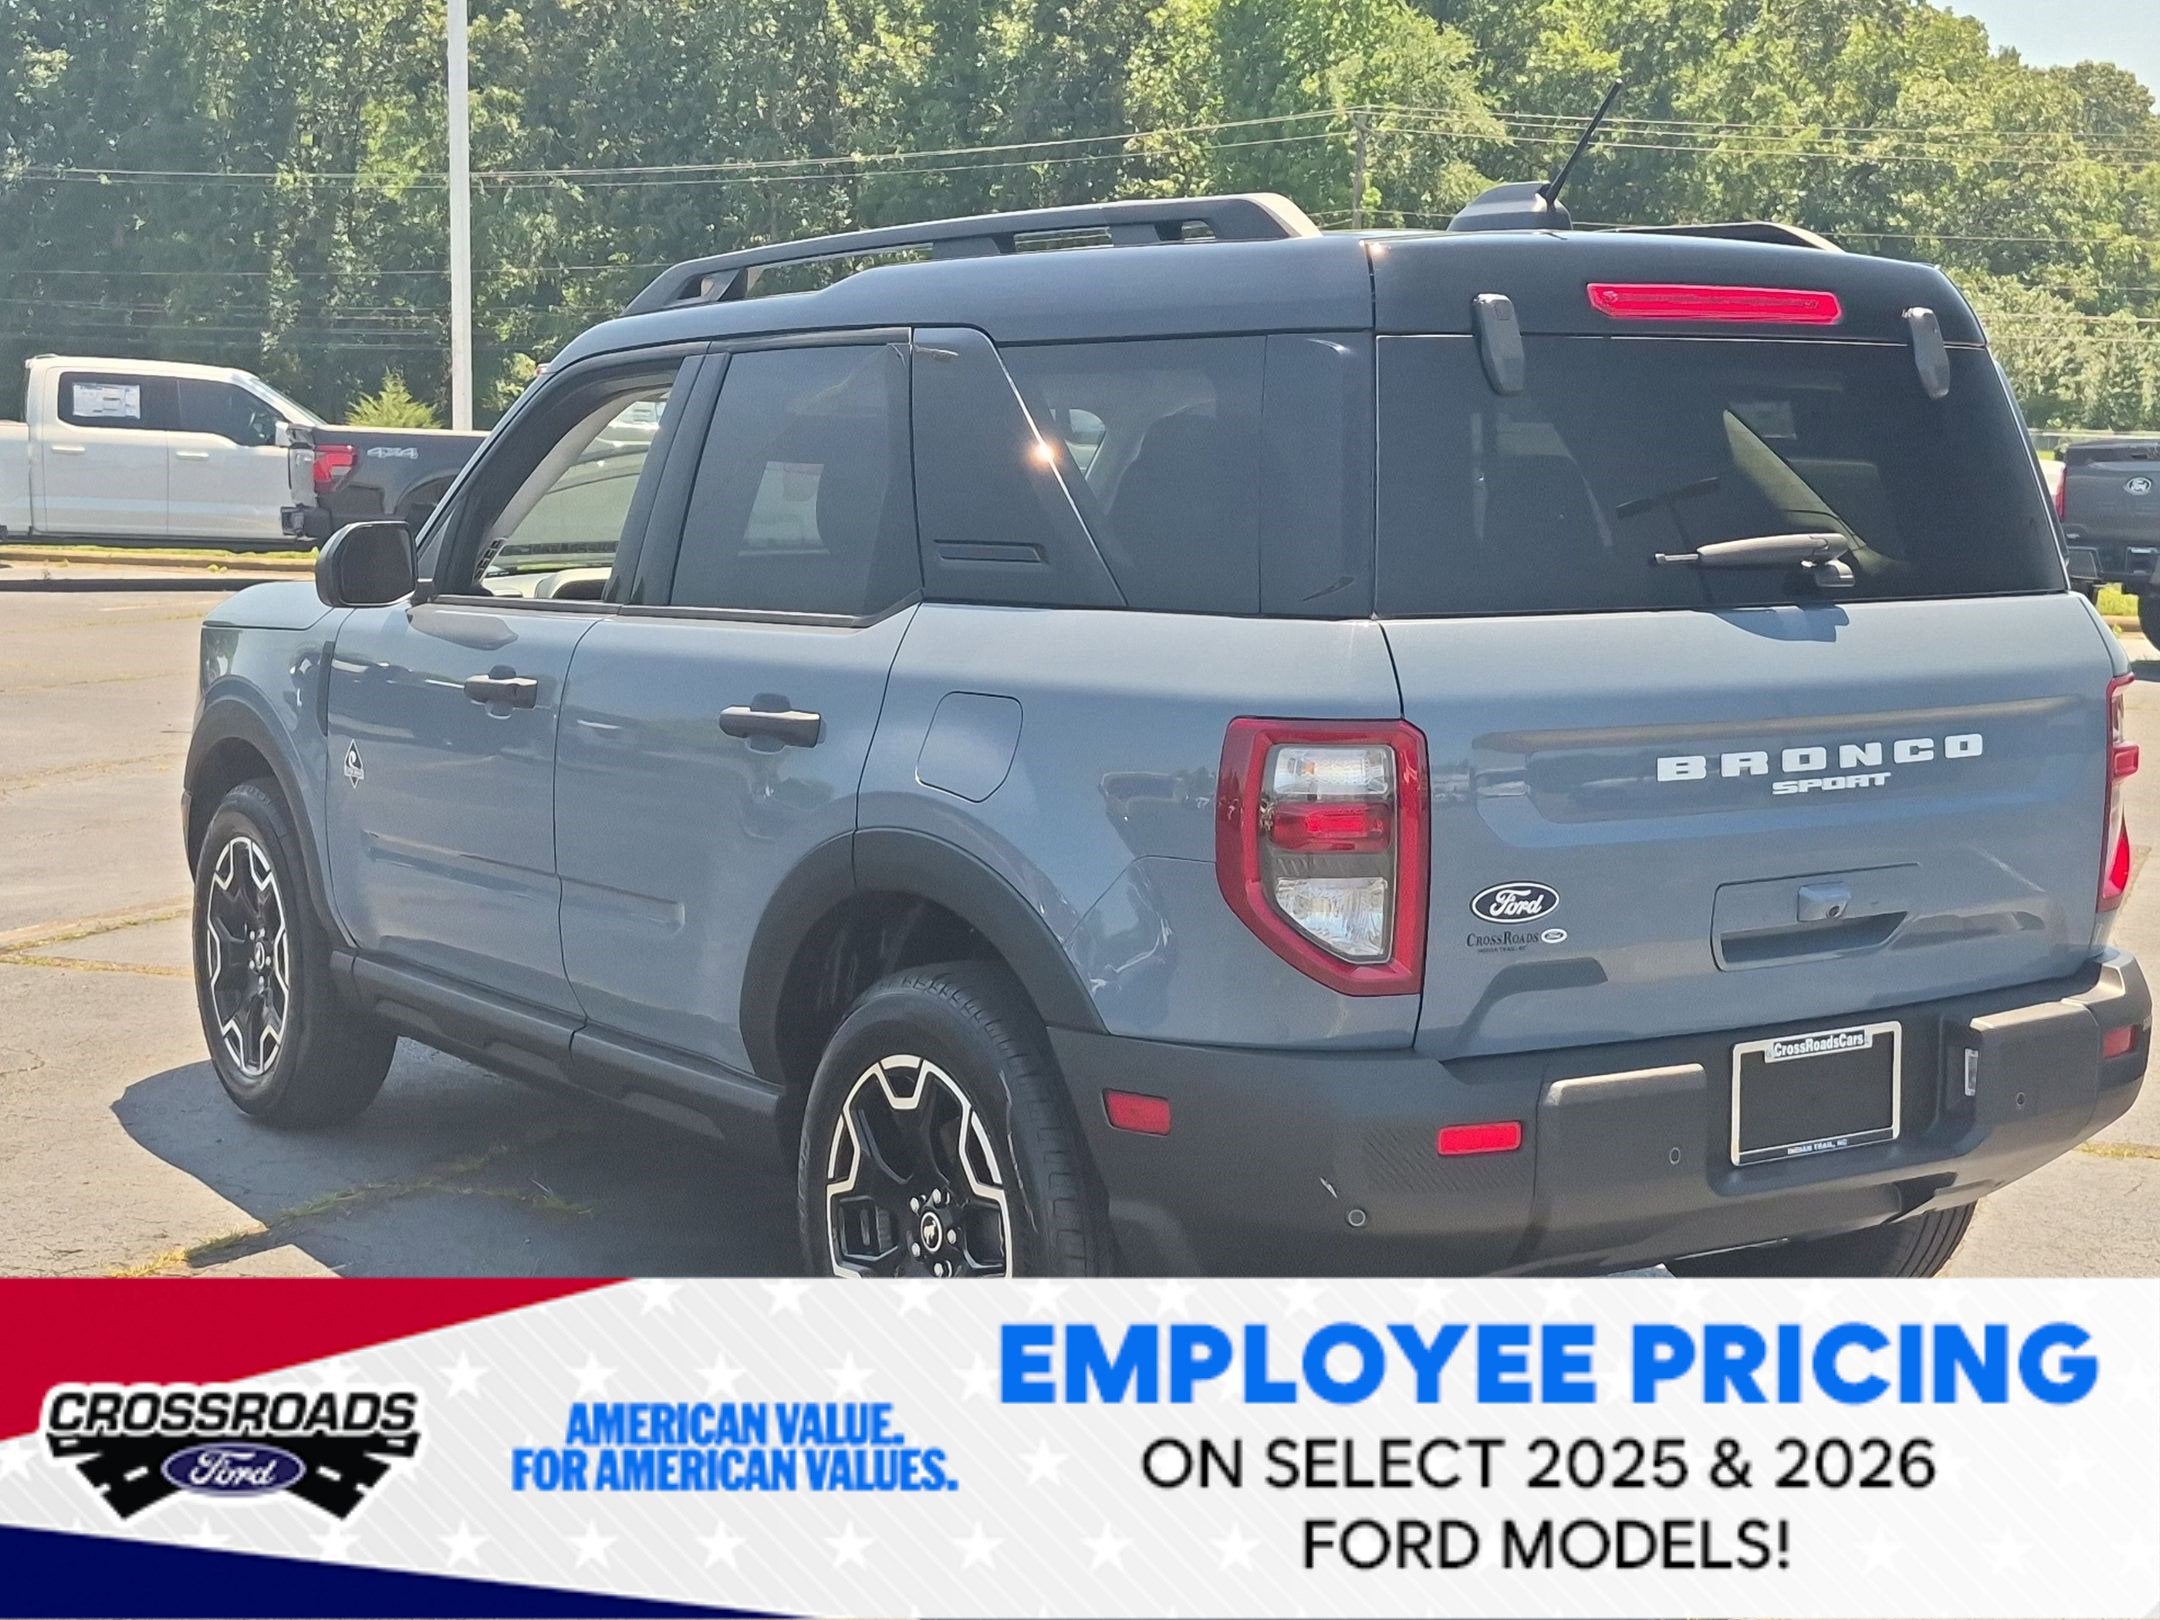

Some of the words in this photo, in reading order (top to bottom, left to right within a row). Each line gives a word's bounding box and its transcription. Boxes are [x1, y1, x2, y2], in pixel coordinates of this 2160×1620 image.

[1657, 733, 1983, 782] BRONCO
[1772, 772, 1891, 795] SPORT
[1489, 889, 1545, 917] Ford
[1773, 1033, 1864, 1058] CrossRoadsCars
